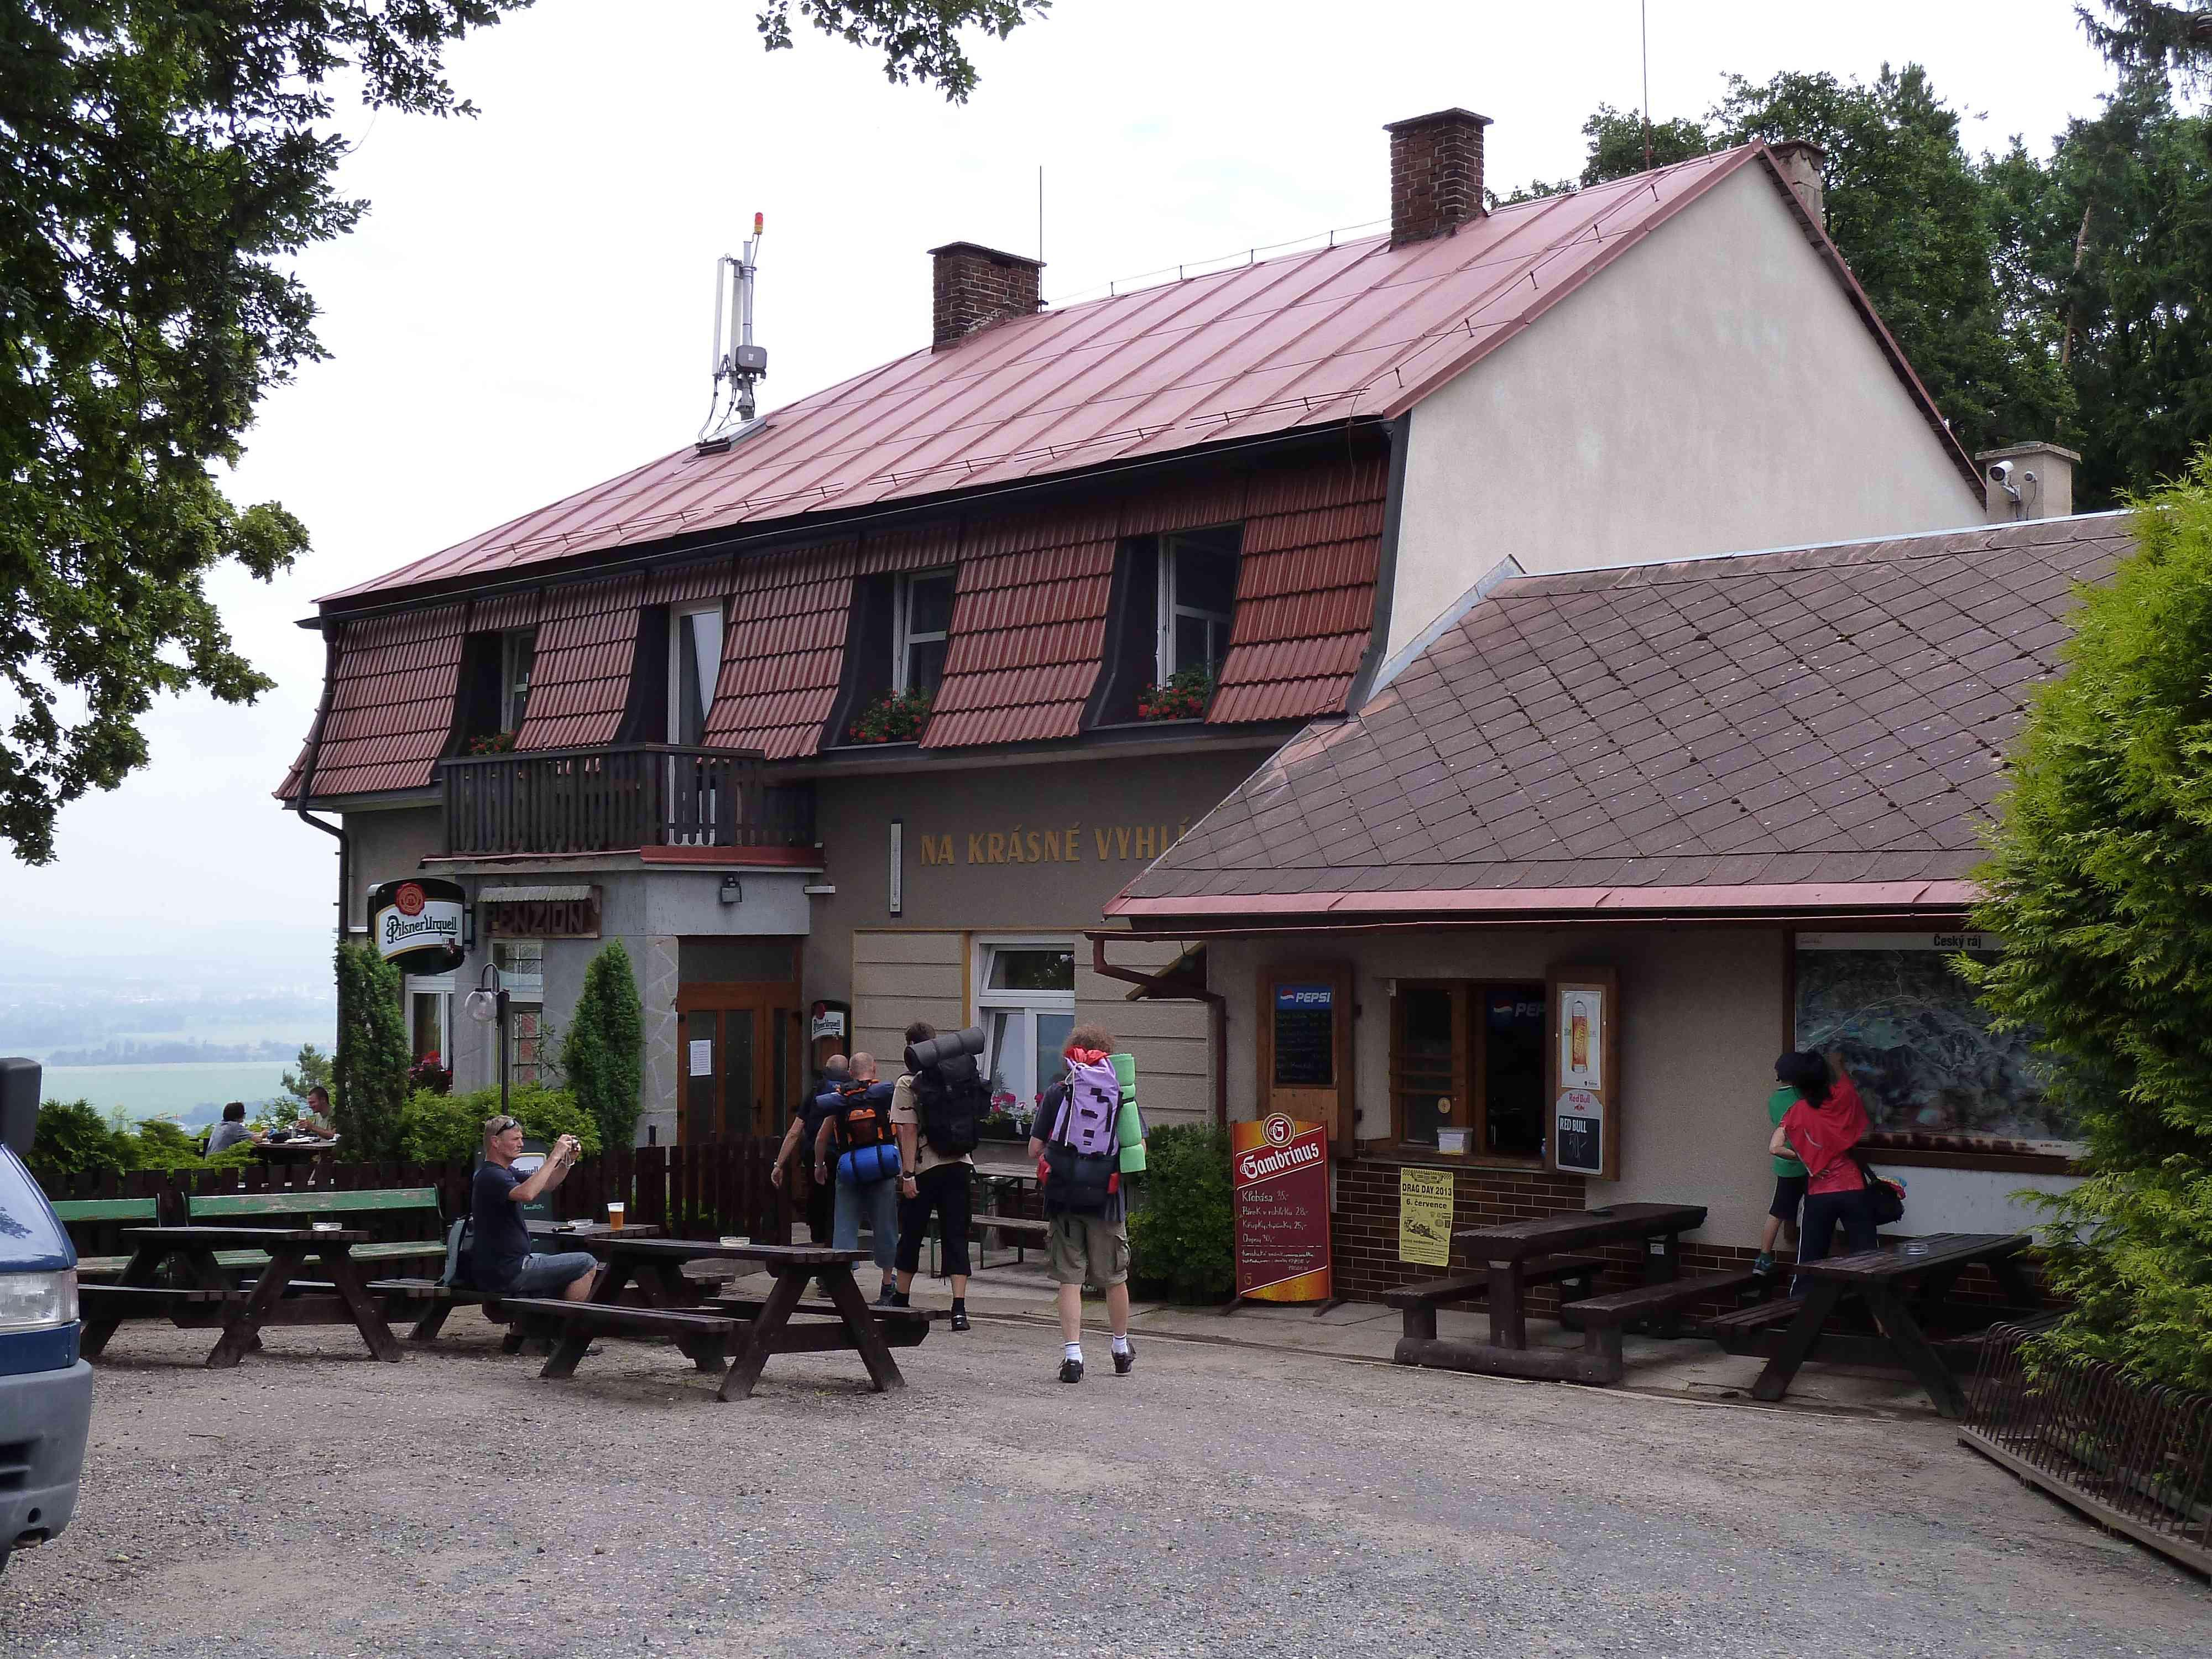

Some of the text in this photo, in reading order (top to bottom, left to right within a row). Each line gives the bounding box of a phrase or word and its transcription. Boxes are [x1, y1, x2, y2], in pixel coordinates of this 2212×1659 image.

[920, 833, 955, 865] NA
[967, 821, 1083, 864] KRÁSNÉ
[386, 914, 457, 944] Pilsner Urquell
[1934, 933, 1981, 948] Český ráj
[1296, 992, 1331, 1003] PEPSI
[1569, 1093, 1590, 1104] Red Bull
[1559, 1118, 1587, 1133] RED BULL
[1239, 1142, 1319, 1180] Gambrinus
[1402, 1183, 1420, 1193] DRAG
[1421, 1185, 1434, 1194] DAY
[1436, 1187, 1452, 1196] 2013
[1415, 1199, 1447, 1209] července
